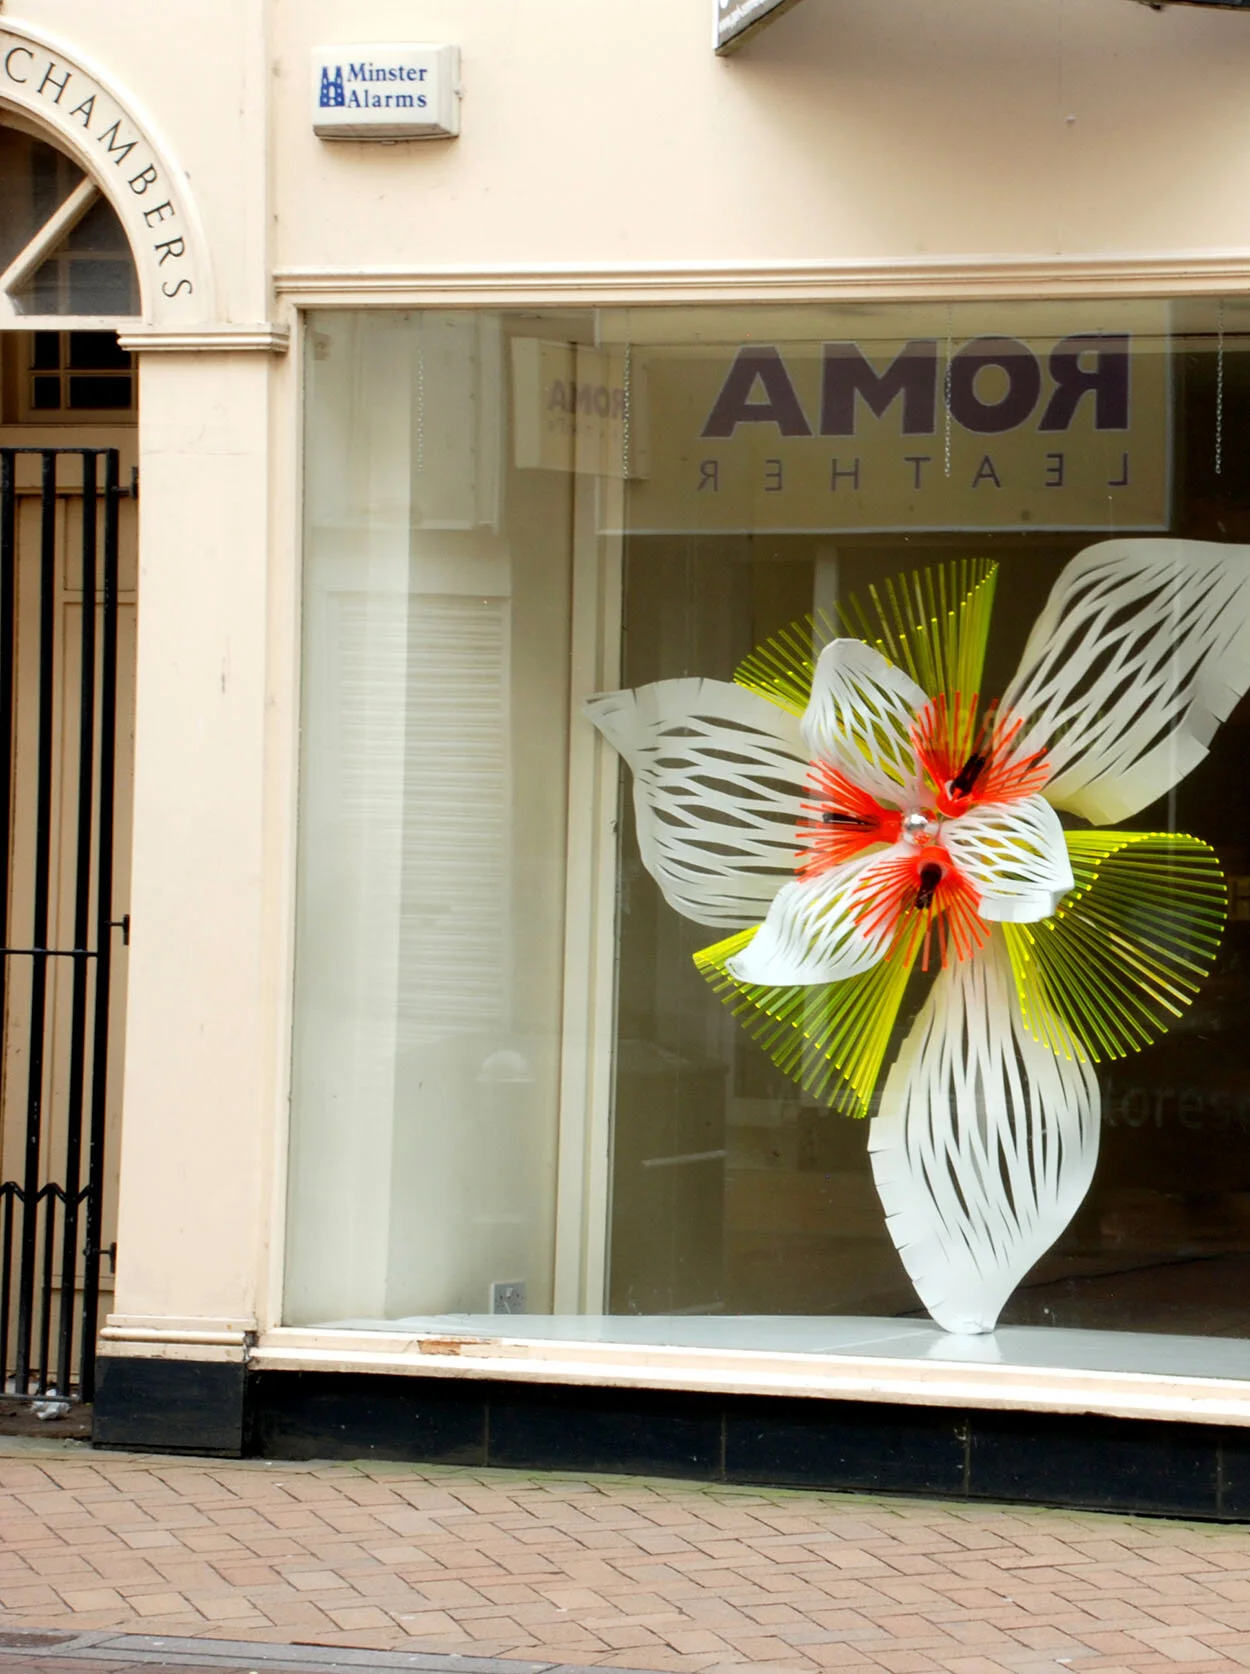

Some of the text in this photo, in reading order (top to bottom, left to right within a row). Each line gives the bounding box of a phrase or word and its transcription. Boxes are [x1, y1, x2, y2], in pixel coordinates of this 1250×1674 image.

[347, 62, 428, 82] Minster
[346, 89, 428, 109] Alarms
[4, 46, 194, 298] CHAMBERS
